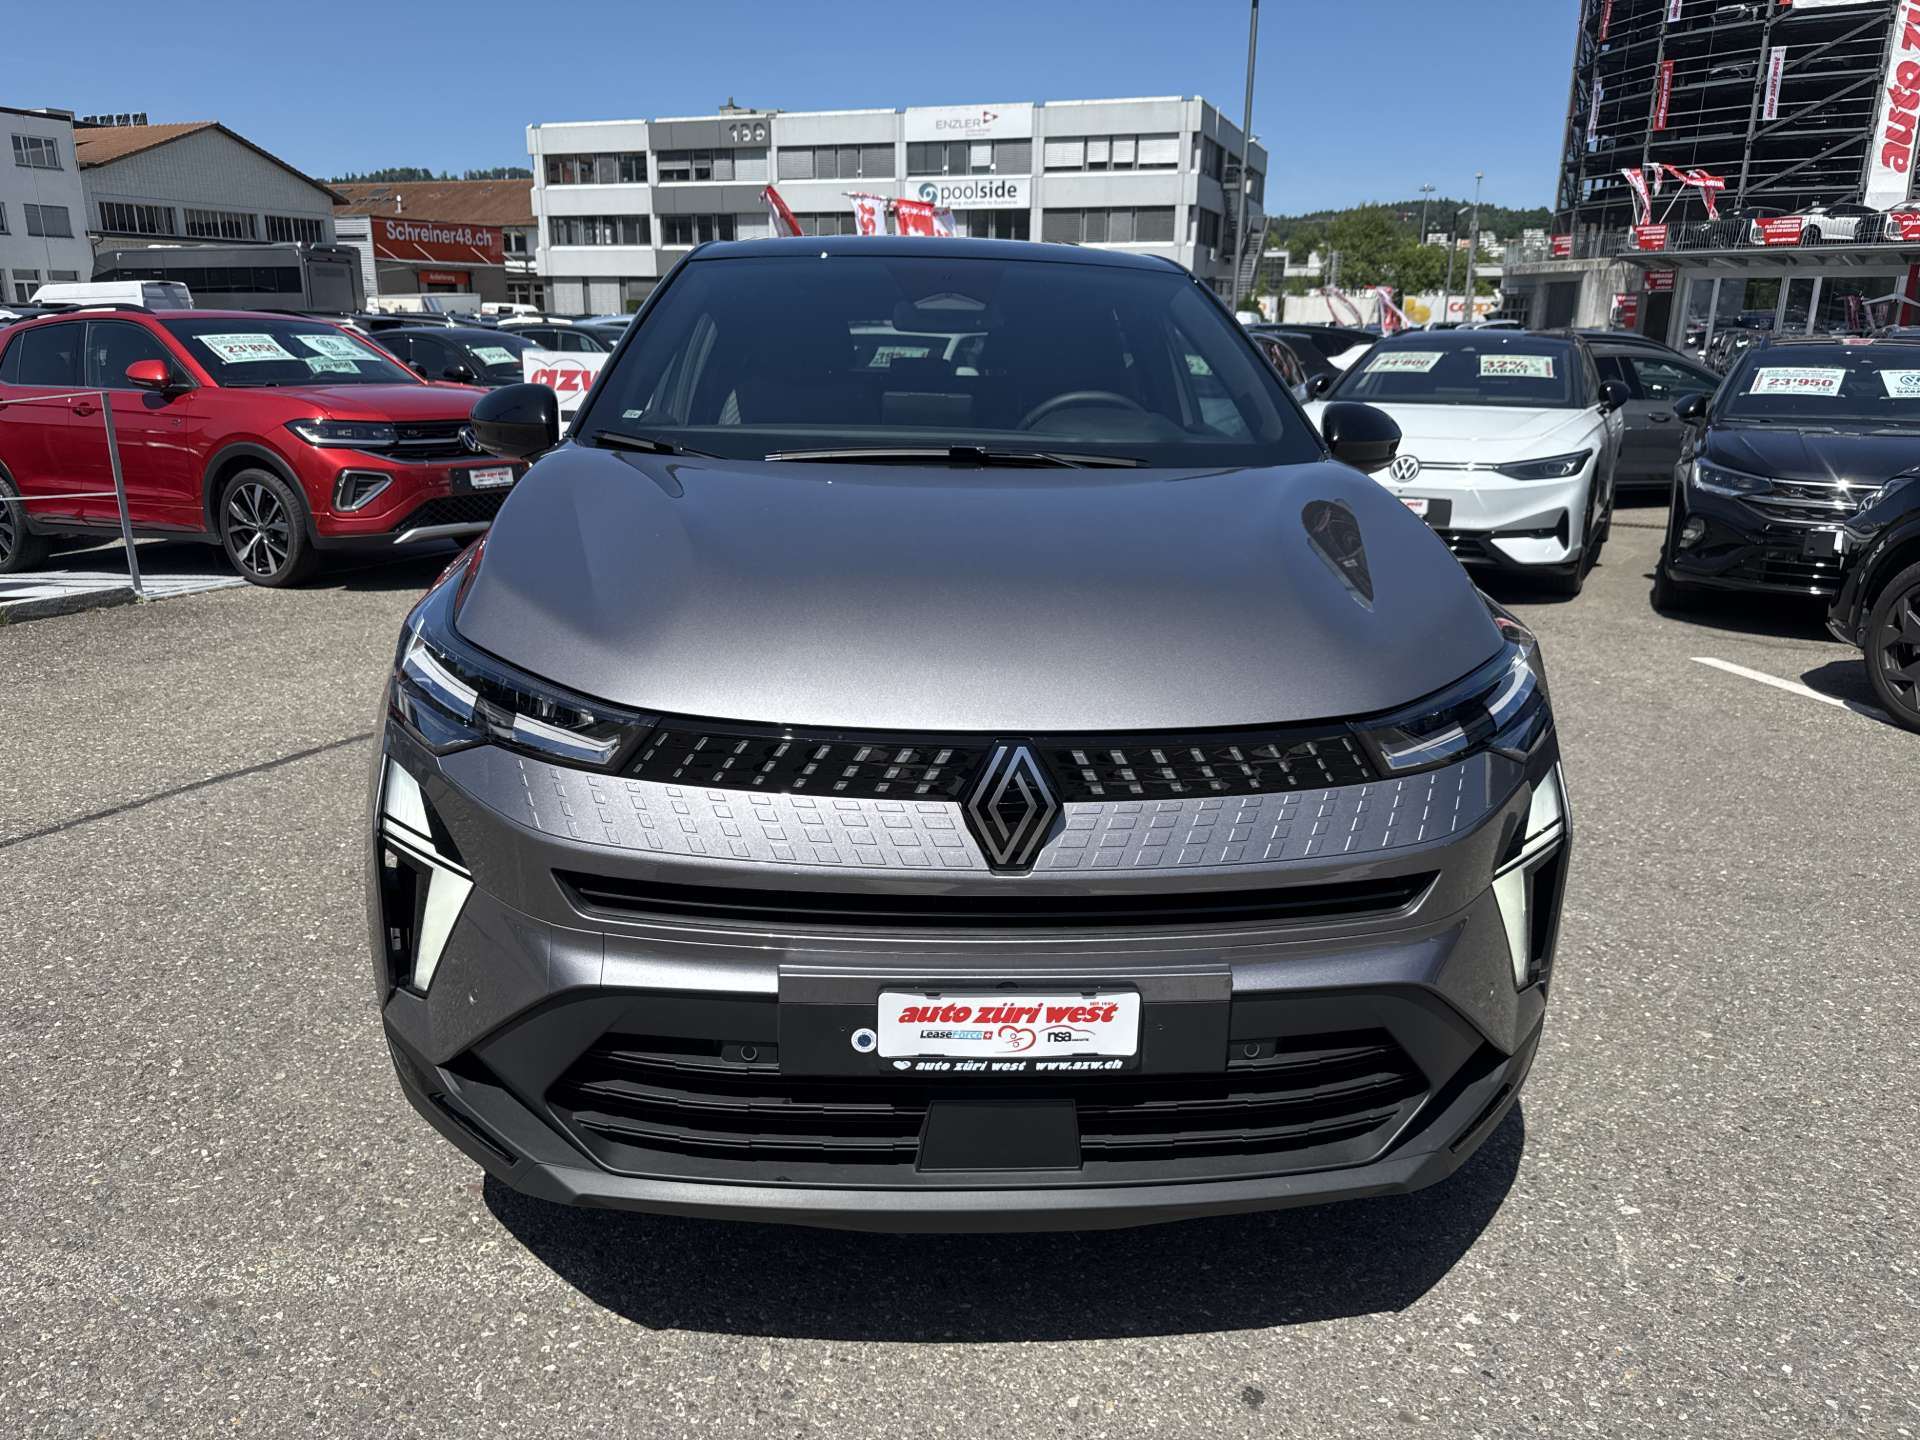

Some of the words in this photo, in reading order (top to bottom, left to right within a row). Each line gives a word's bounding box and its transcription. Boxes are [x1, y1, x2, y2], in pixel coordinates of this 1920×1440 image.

[936, 119, 981, 129] ENZLER
[941, 180, 1017, 205] poolside
[386, 220, 493, 246] Schreiner48.ch
[1768, 378, 1834, 386] 23'950
[898, 1003, 972, 1023] auto
[972, 1003, 1043, 1023] züri
[1046, 1003, 1119, 1023] west
[1047, 1031, 1072, 1042] nsa
[915, 1061, 951, 1071] auto
[953, 1060, 988, 1071] züri
[991, 1061, 1027, 1071] west
[1035, 1059, 1123, 1071] www.azw.ch
